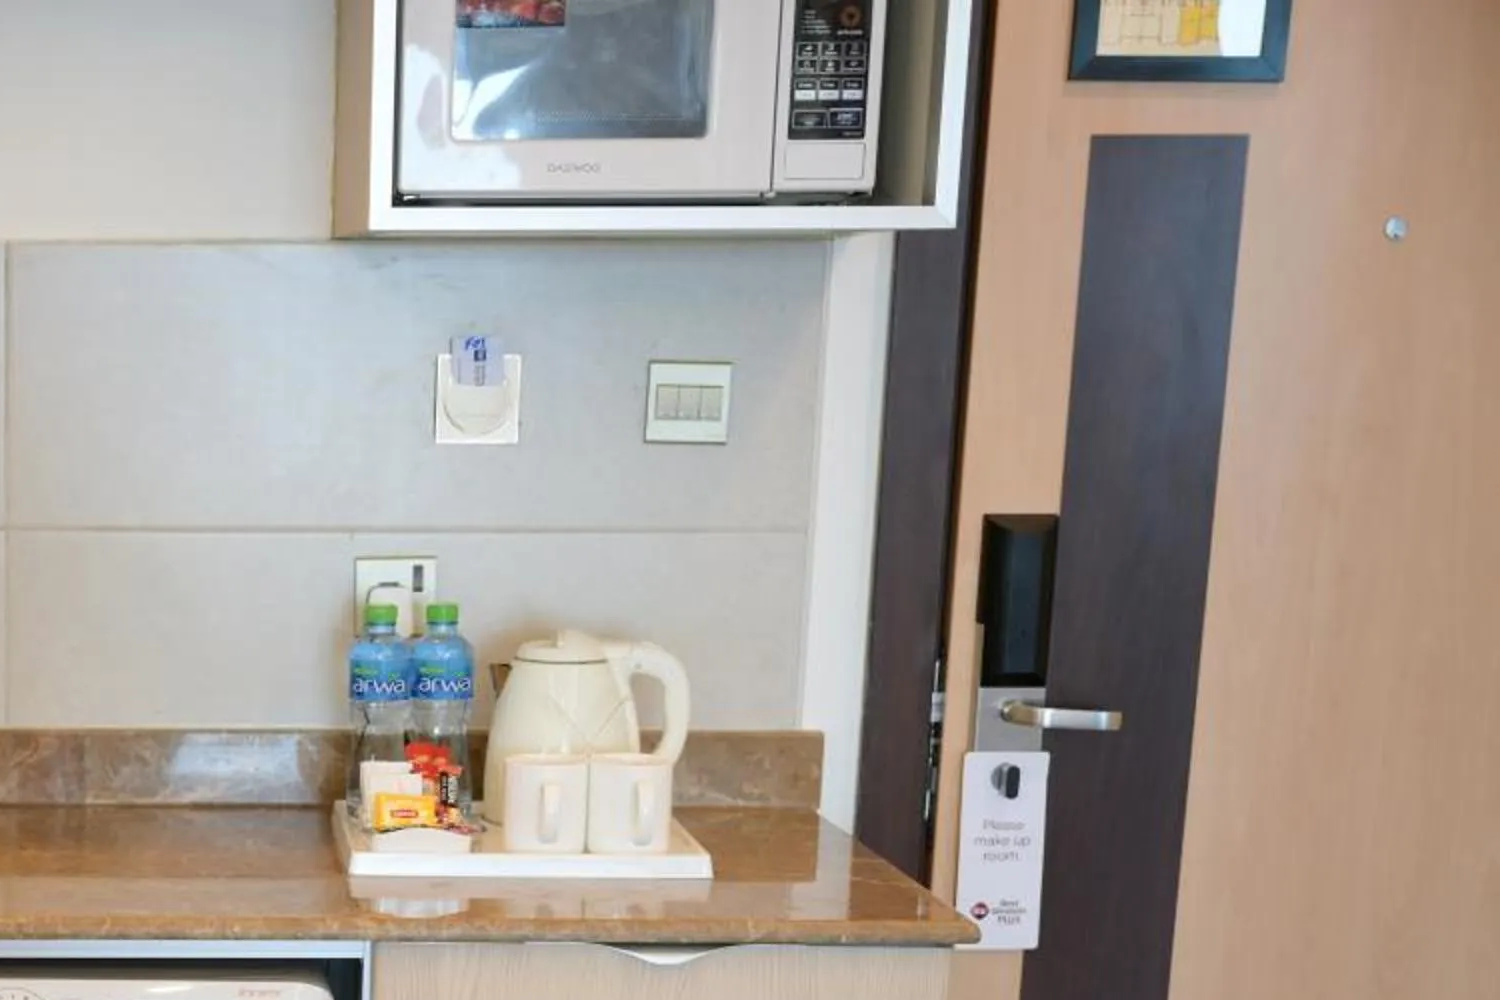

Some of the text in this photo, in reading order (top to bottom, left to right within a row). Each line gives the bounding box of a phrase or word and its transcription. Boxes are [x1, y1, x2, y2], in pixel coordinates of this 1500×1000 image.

[353, 677, 406, 694] arwa
[418, 676, 471, 693] arwa
[974, 834, 1031, 848] make up
